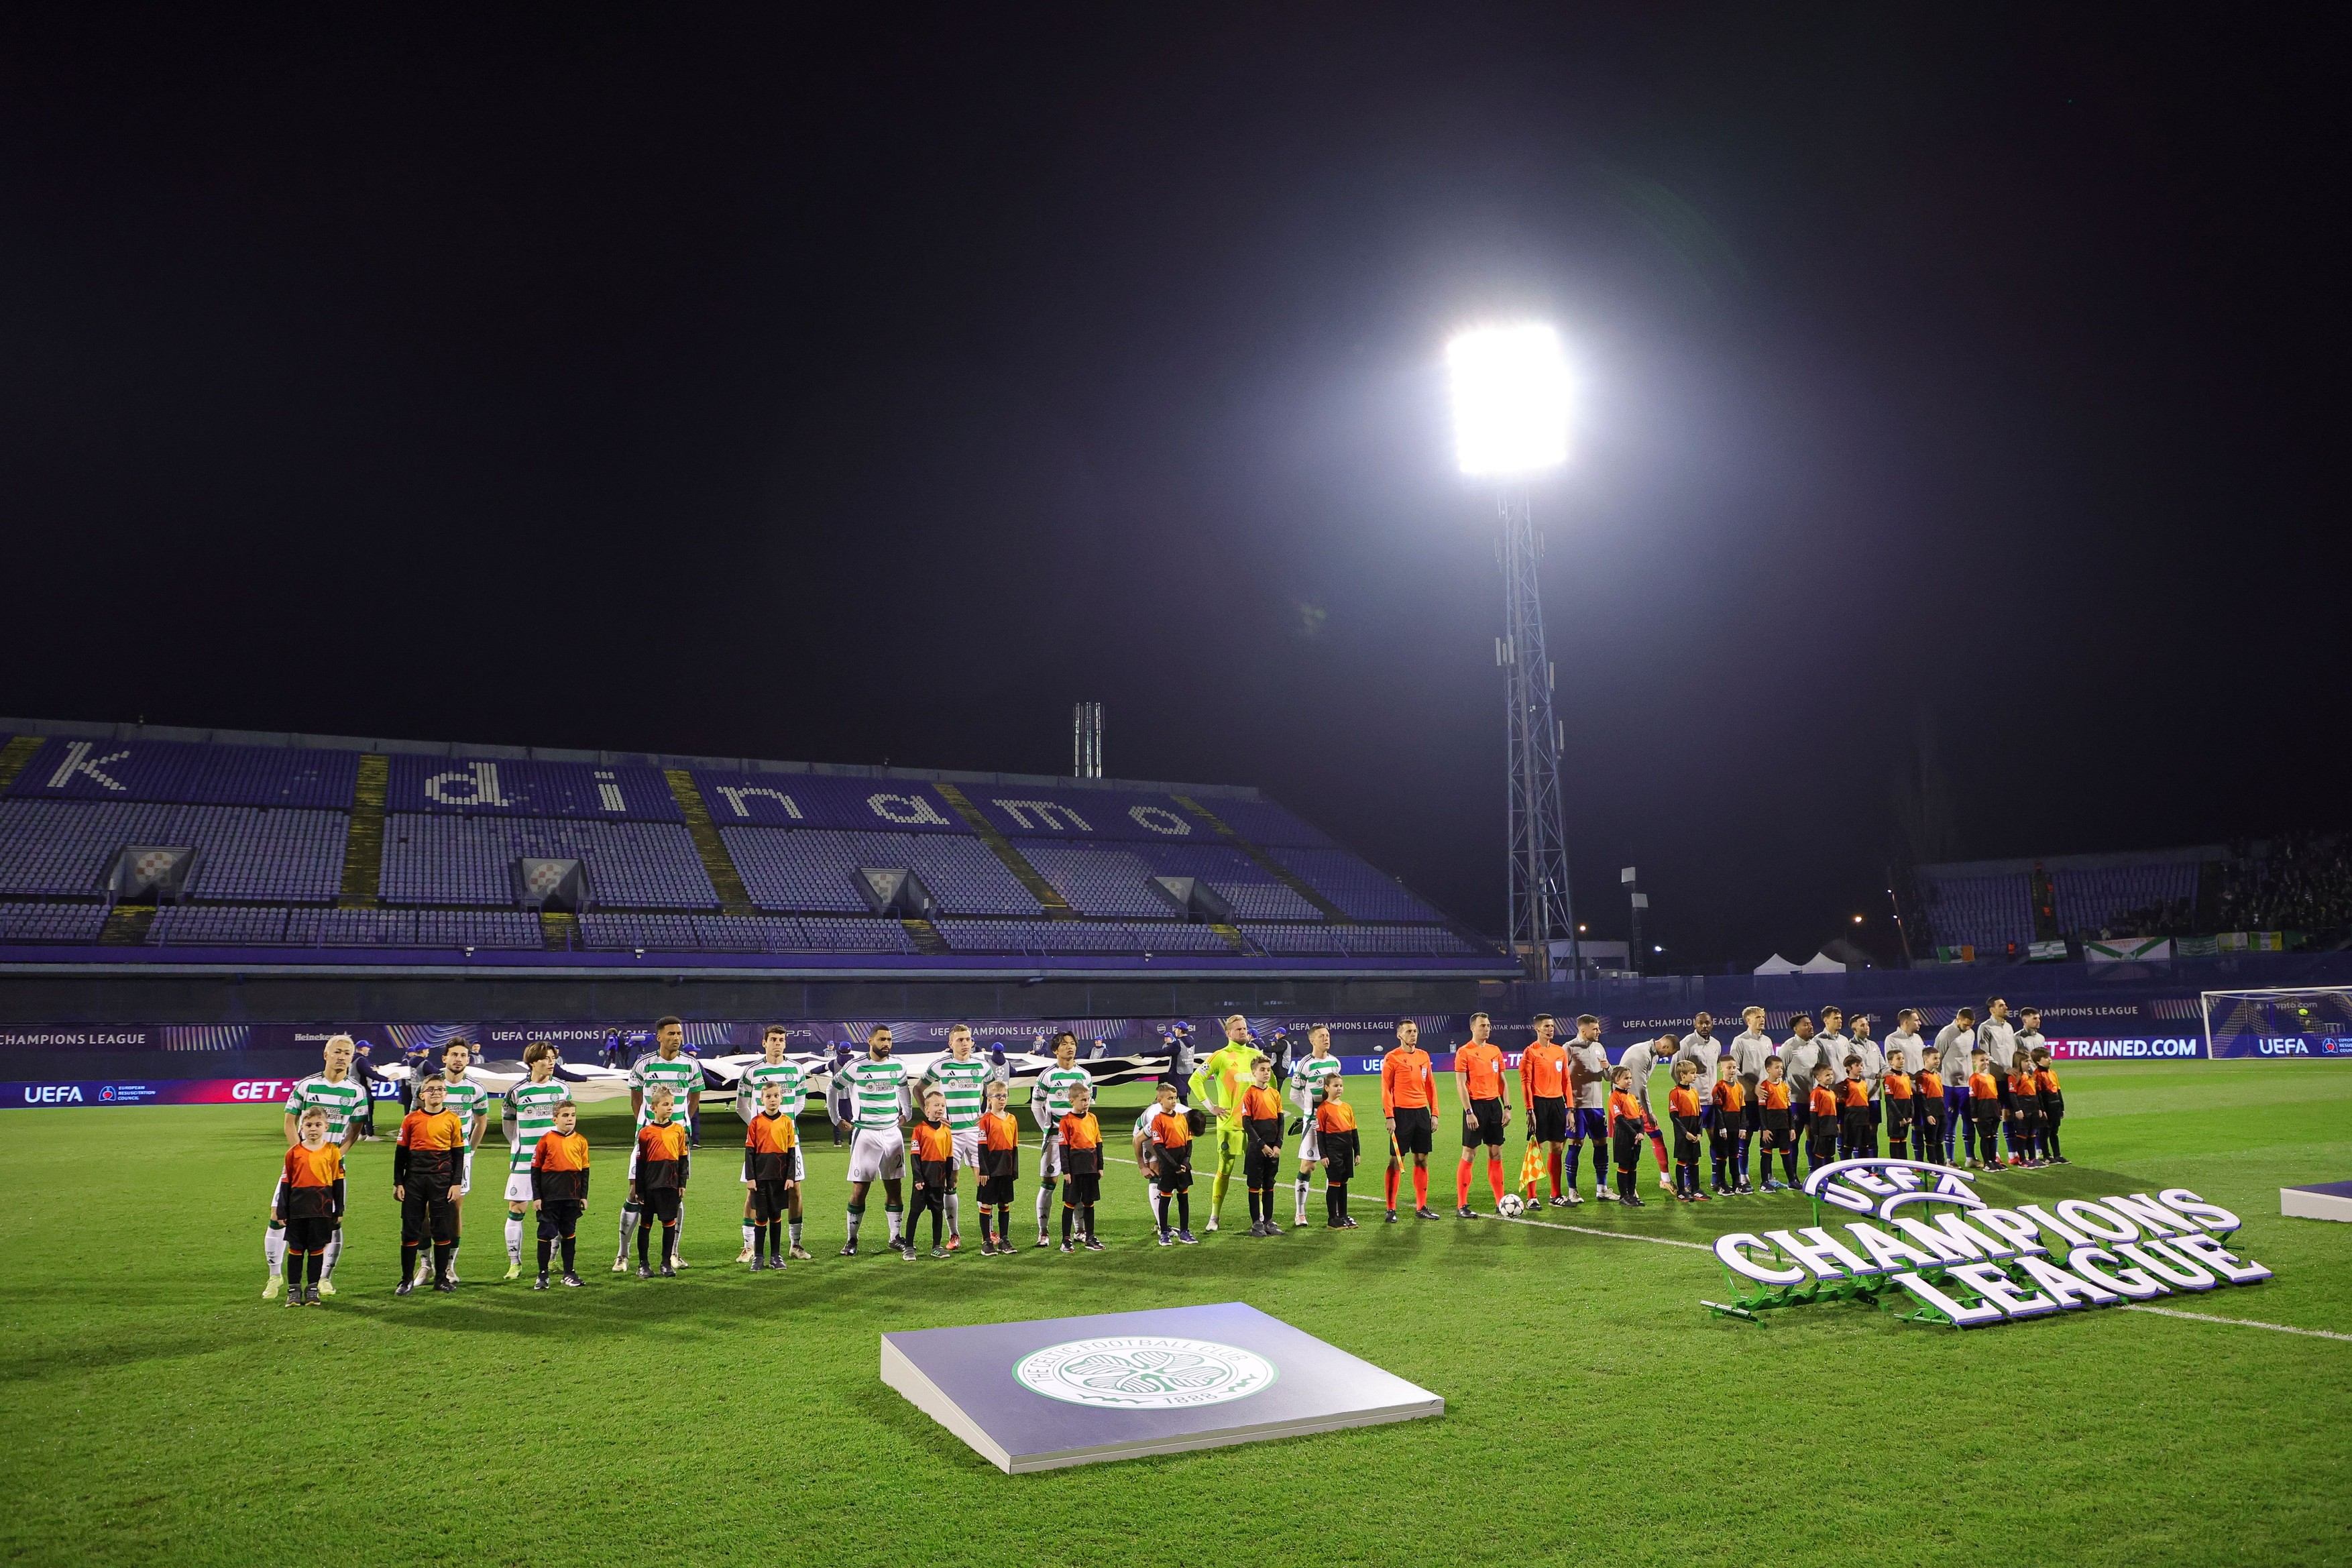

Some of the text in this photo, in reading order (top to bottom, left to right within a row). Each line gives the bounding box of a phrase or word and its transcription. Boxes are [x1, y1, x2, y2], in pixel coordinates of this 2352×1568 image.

[2039, 1007, 2092, 1017] AMPIONS
[2096, 1006, 2138, 1015] LEAGUE
[1290, 1022, 1310, 1031] UEFA
[1363, 1021, 1394, 1029] LEAGUE
[1623, 1017, 1743, 1028] UEFA CHAMPIO EAGUE
[492, 1031, 523, 1041] UEFA
[526, 1031, 600, 1040] CHAMPIONS
[930, 1026, 1058, 1036] UEF AMPIONS LEAGUE
[89, 1033, 146, 1044] LEAGUE
[2045, 1039, 2196, 1056] T-TRAINED.COM
[2259, 1038, 2309, 1054] UEFA
[25, 1086, 83, 1103] UEFA
[1822, 1167, 1981, 1213] UEFA
[1713, 1188, 2241, 1284] CHAMPIONS
[1890, 1233, 2274, 1325] LEAGUE
[1027, 1339, 1248, 1383] THE CELTIC FOOTBALL CLUB
[1163, 1393, 1218, 1404] 1888
